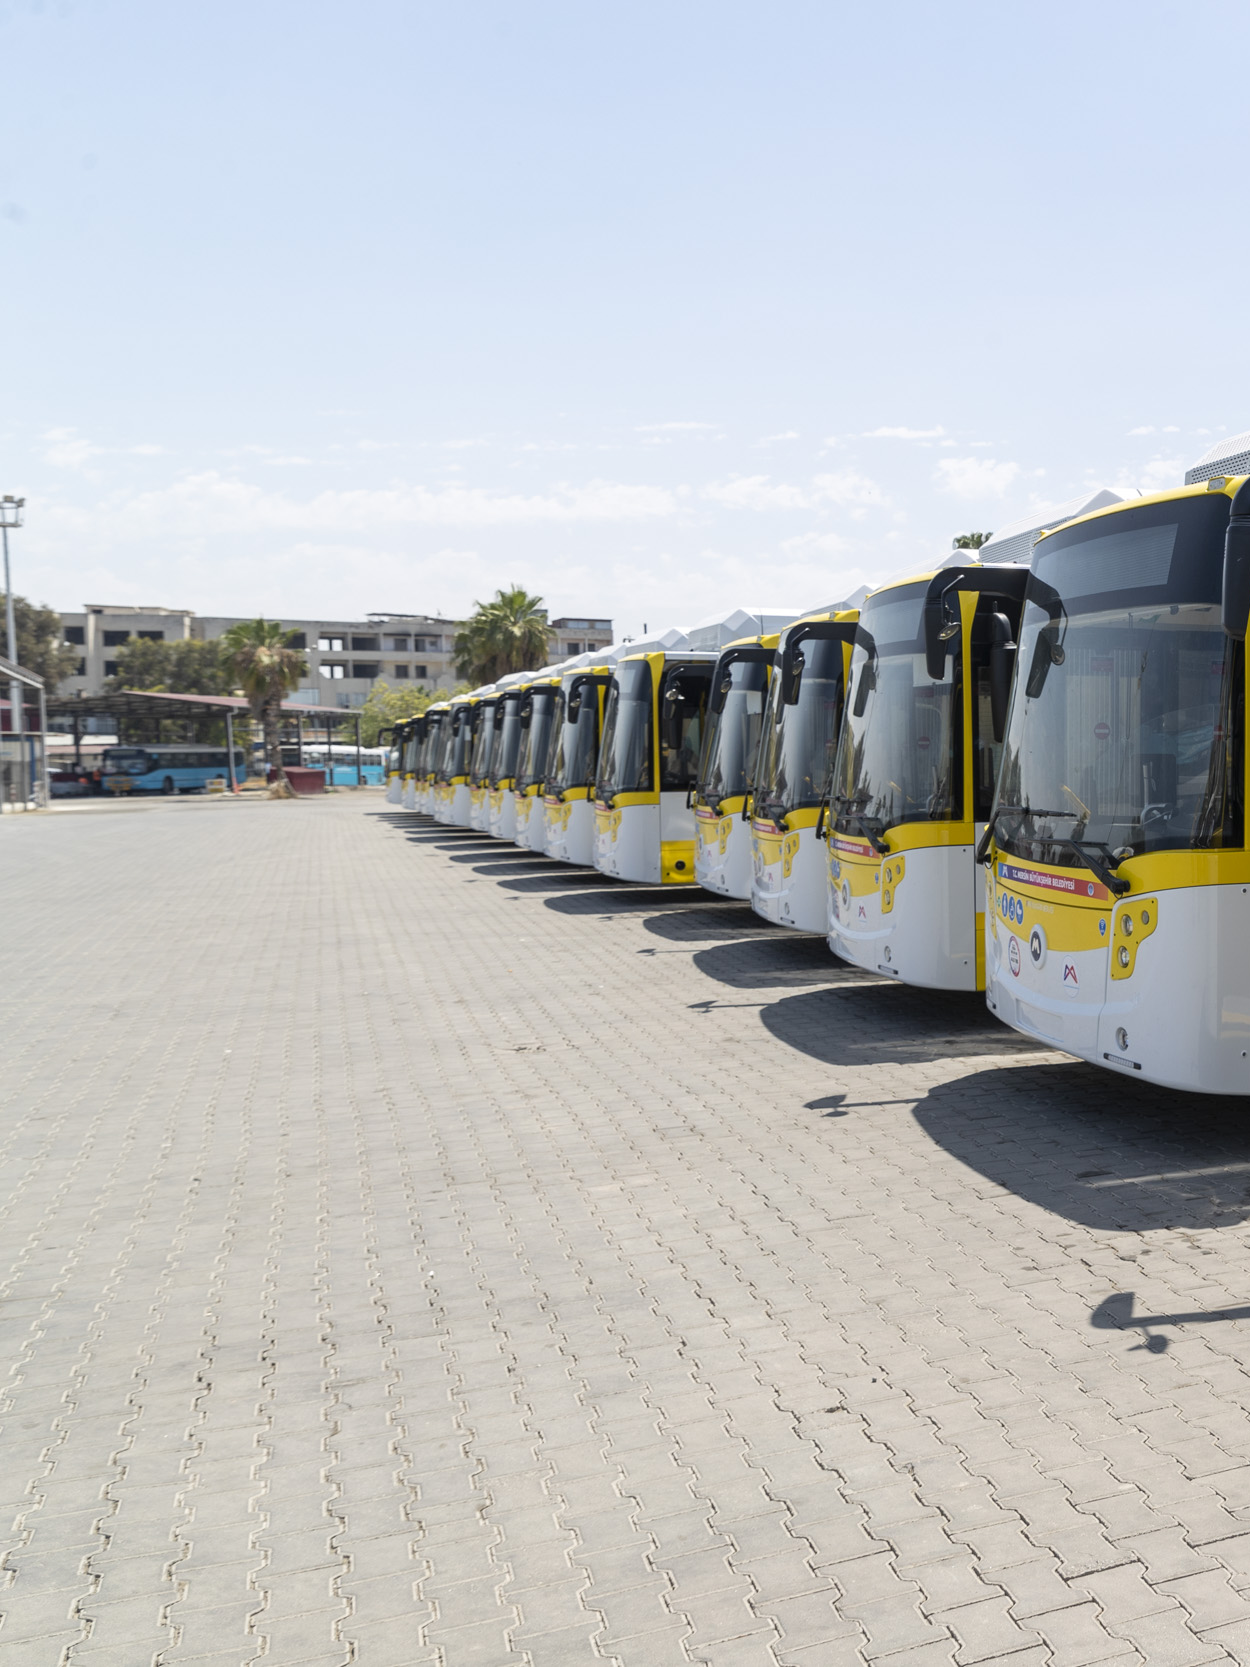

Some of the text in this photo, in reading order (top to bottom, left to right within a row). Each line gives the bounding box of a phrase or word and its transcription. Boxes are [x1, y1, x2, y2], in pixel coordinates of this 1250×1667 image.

[1018, 870, 1029, 881] MERSİN
[1029, 871, 1052, 886] BÜYÜKŞEHİR
[1052, 877, 1075, 890] BELEDİYESİ
